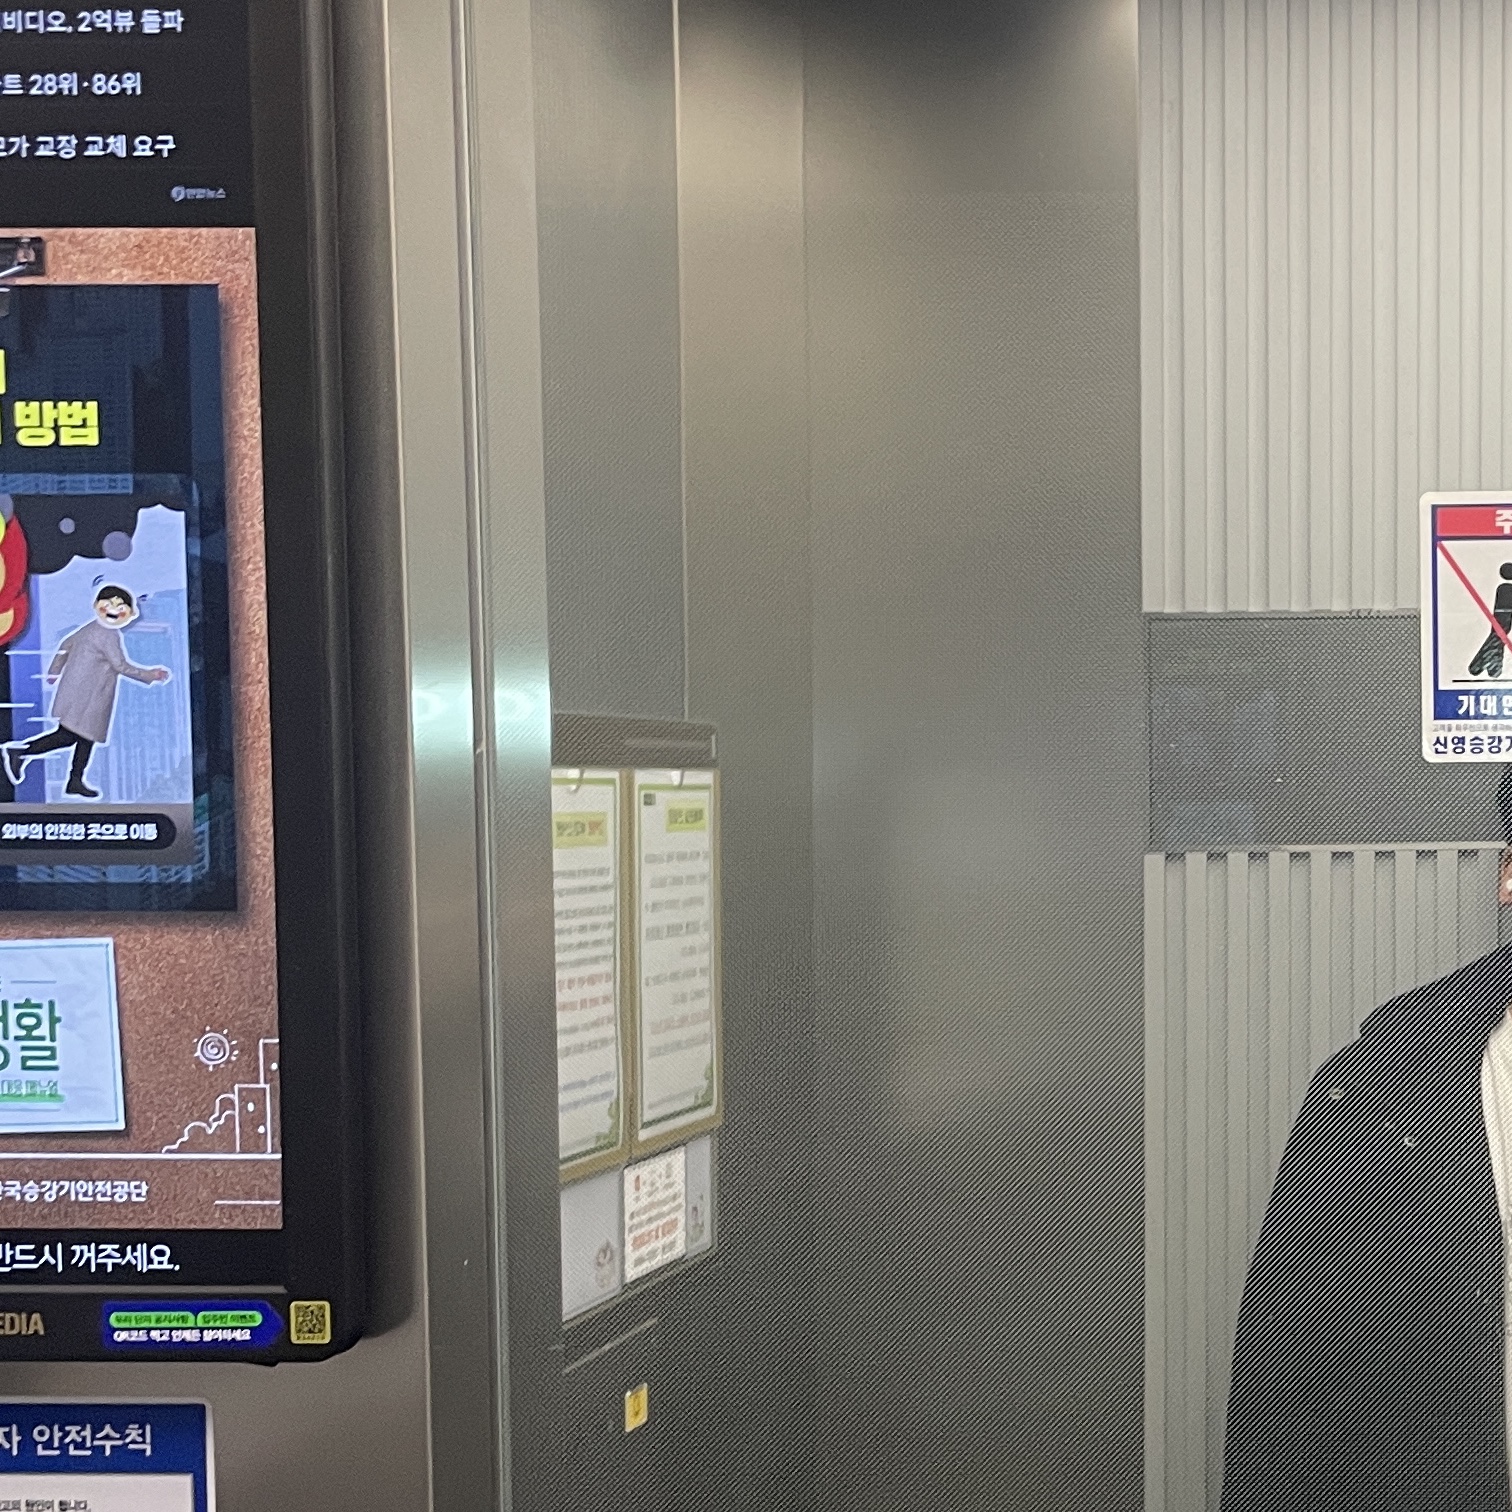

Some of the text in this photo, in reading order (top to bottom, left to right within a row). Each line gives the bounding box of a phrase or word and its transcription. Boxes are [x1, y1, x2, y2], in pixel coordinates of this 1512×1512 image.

[77, 9, 136, 33] 2억뷰
[140, 9, 185, 34] 돌파
[0, 73, 24, 95] 트
[34, 134, 79, 159] 교장
[83, 134, 127, 158] 교체
[132, 135, 176, 158] 요구
[14, 401, 100, 447] 방법
[1, 823, 158, 840] 외부의 안전한 곳으로 이동
[0, 1180, 150, 1202] 국승강기안전공단
[70, 1242, 181, 1273] 꺼주세요.
[32, 1423, 152, 1456] 안전수칙
